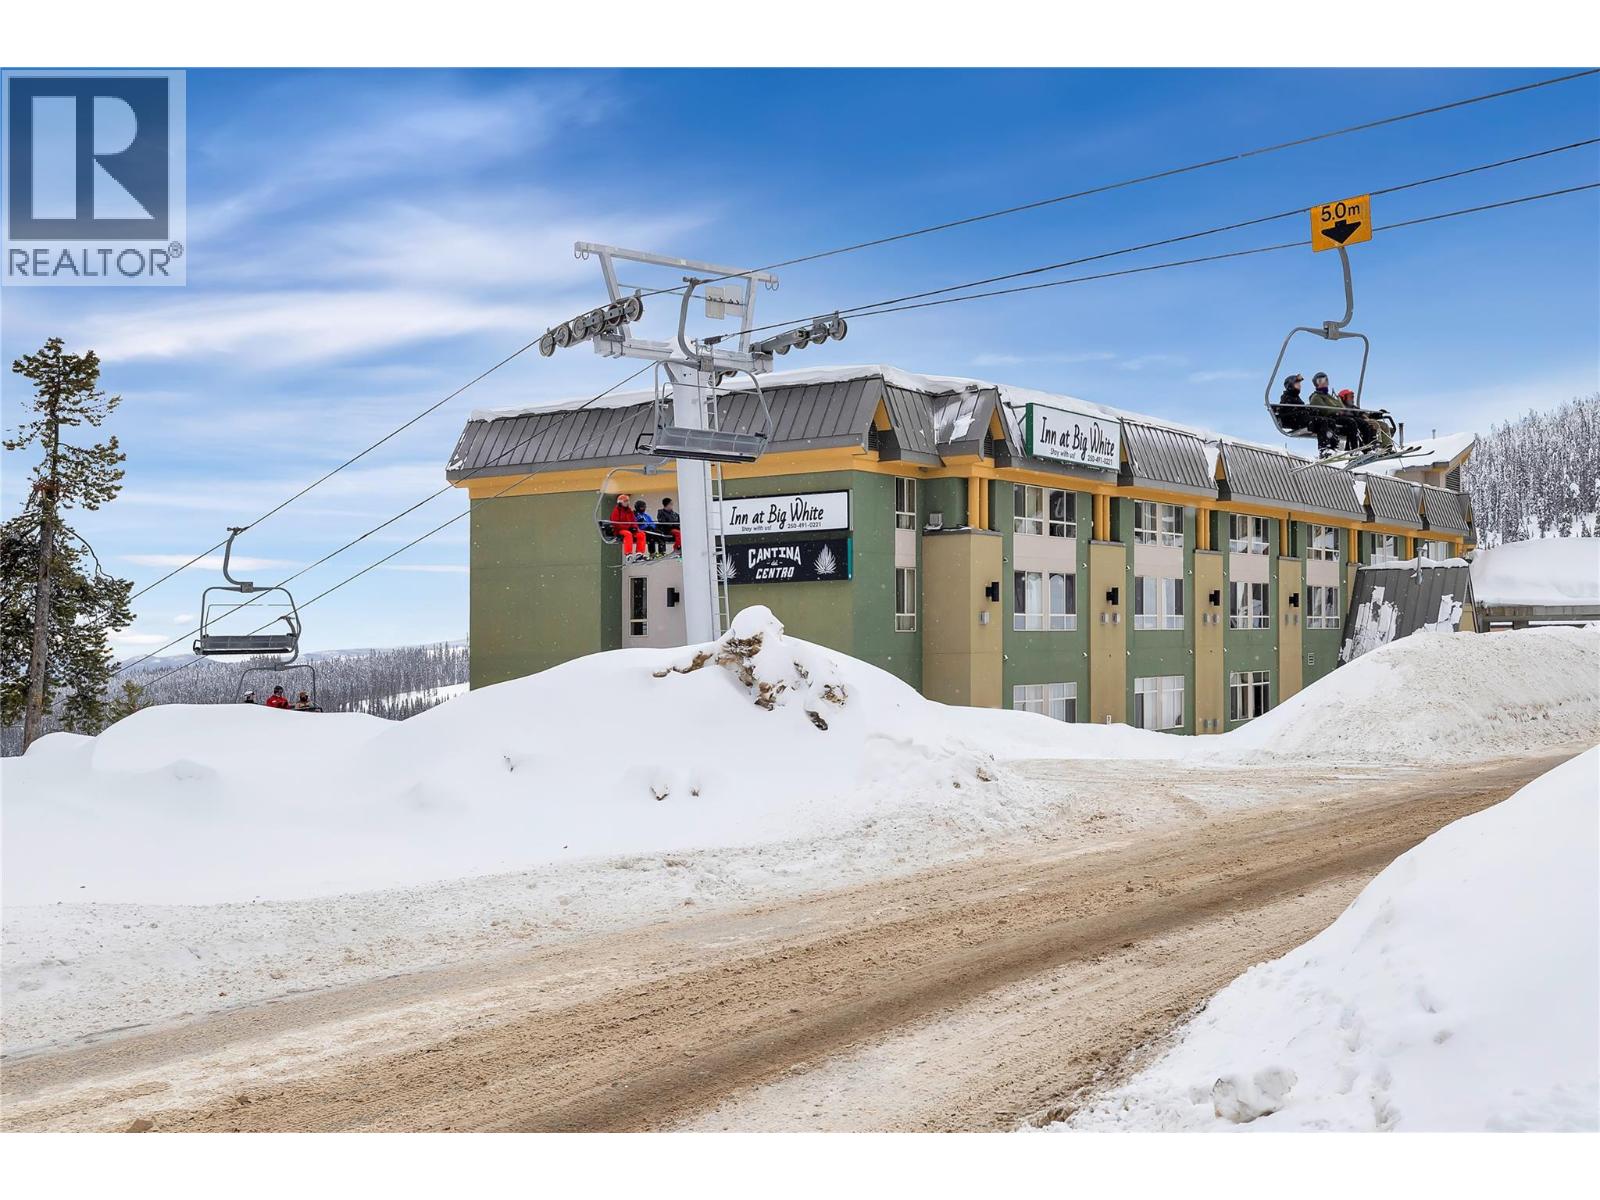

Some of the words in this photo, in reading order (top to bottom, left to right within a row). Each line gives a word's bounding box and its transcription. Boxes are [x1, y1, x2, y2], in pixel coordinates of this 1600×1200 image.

[1321, 202, 1360, 222] 5.0m
[1040, 416, 1057, 446] Inn
[1060, 430, 1070, 448] at
[1072, 424, 1087, 460] Big
[1090, 422, 1115, 456] White
[729, 506, 749, 525] Inn
[752, 511, 765, 524] at
[767, 504, 787, 529] Big
[790, 497, 824, 522] White
[748, 546, 802, 568] CANTINA
[755, 566, 795, 579] CENTRO
